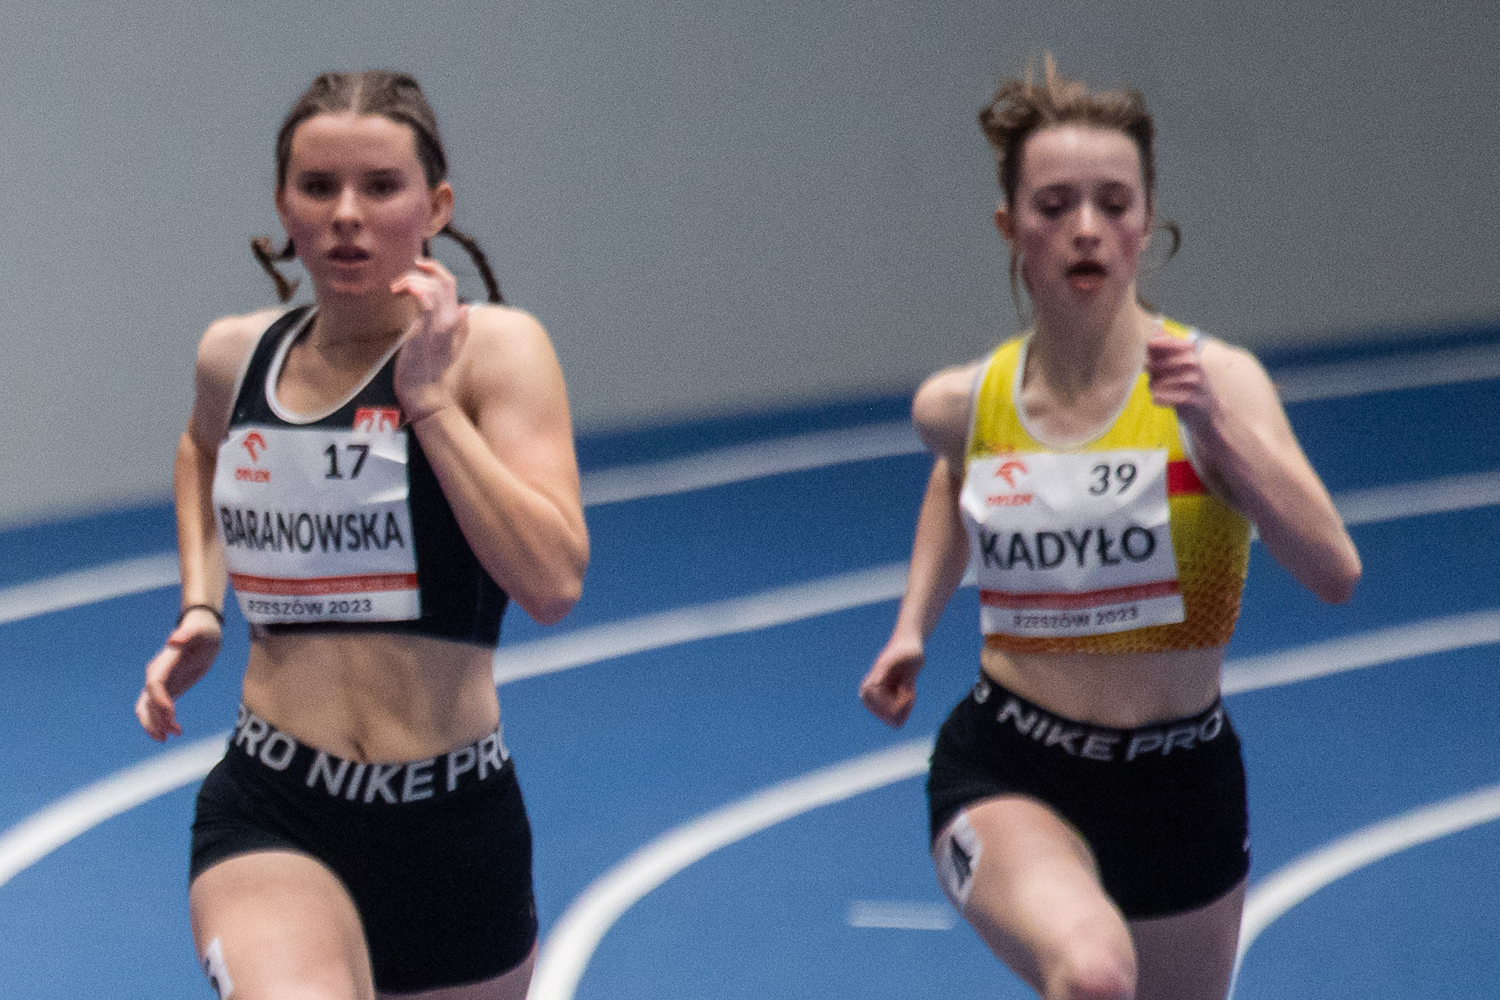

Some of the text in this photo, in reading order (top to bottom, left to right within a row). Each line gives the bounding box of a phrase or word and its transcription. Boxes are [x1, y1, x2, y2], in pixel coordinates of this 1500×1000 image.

[324, 443, 371, 480] 17
[1088, 462, 1137, 497] 39
[220, 507, 404, 553] BARANOWSKA
[979, 526, 1156, 571] KADYŁO
[247, 599, 372, 615] RZESZÓW 2023
[997, 700, 1120, 762] NIKE
[1125, 707, 1223, 762] PRO
[306, 751, 435, 804] NIKE
